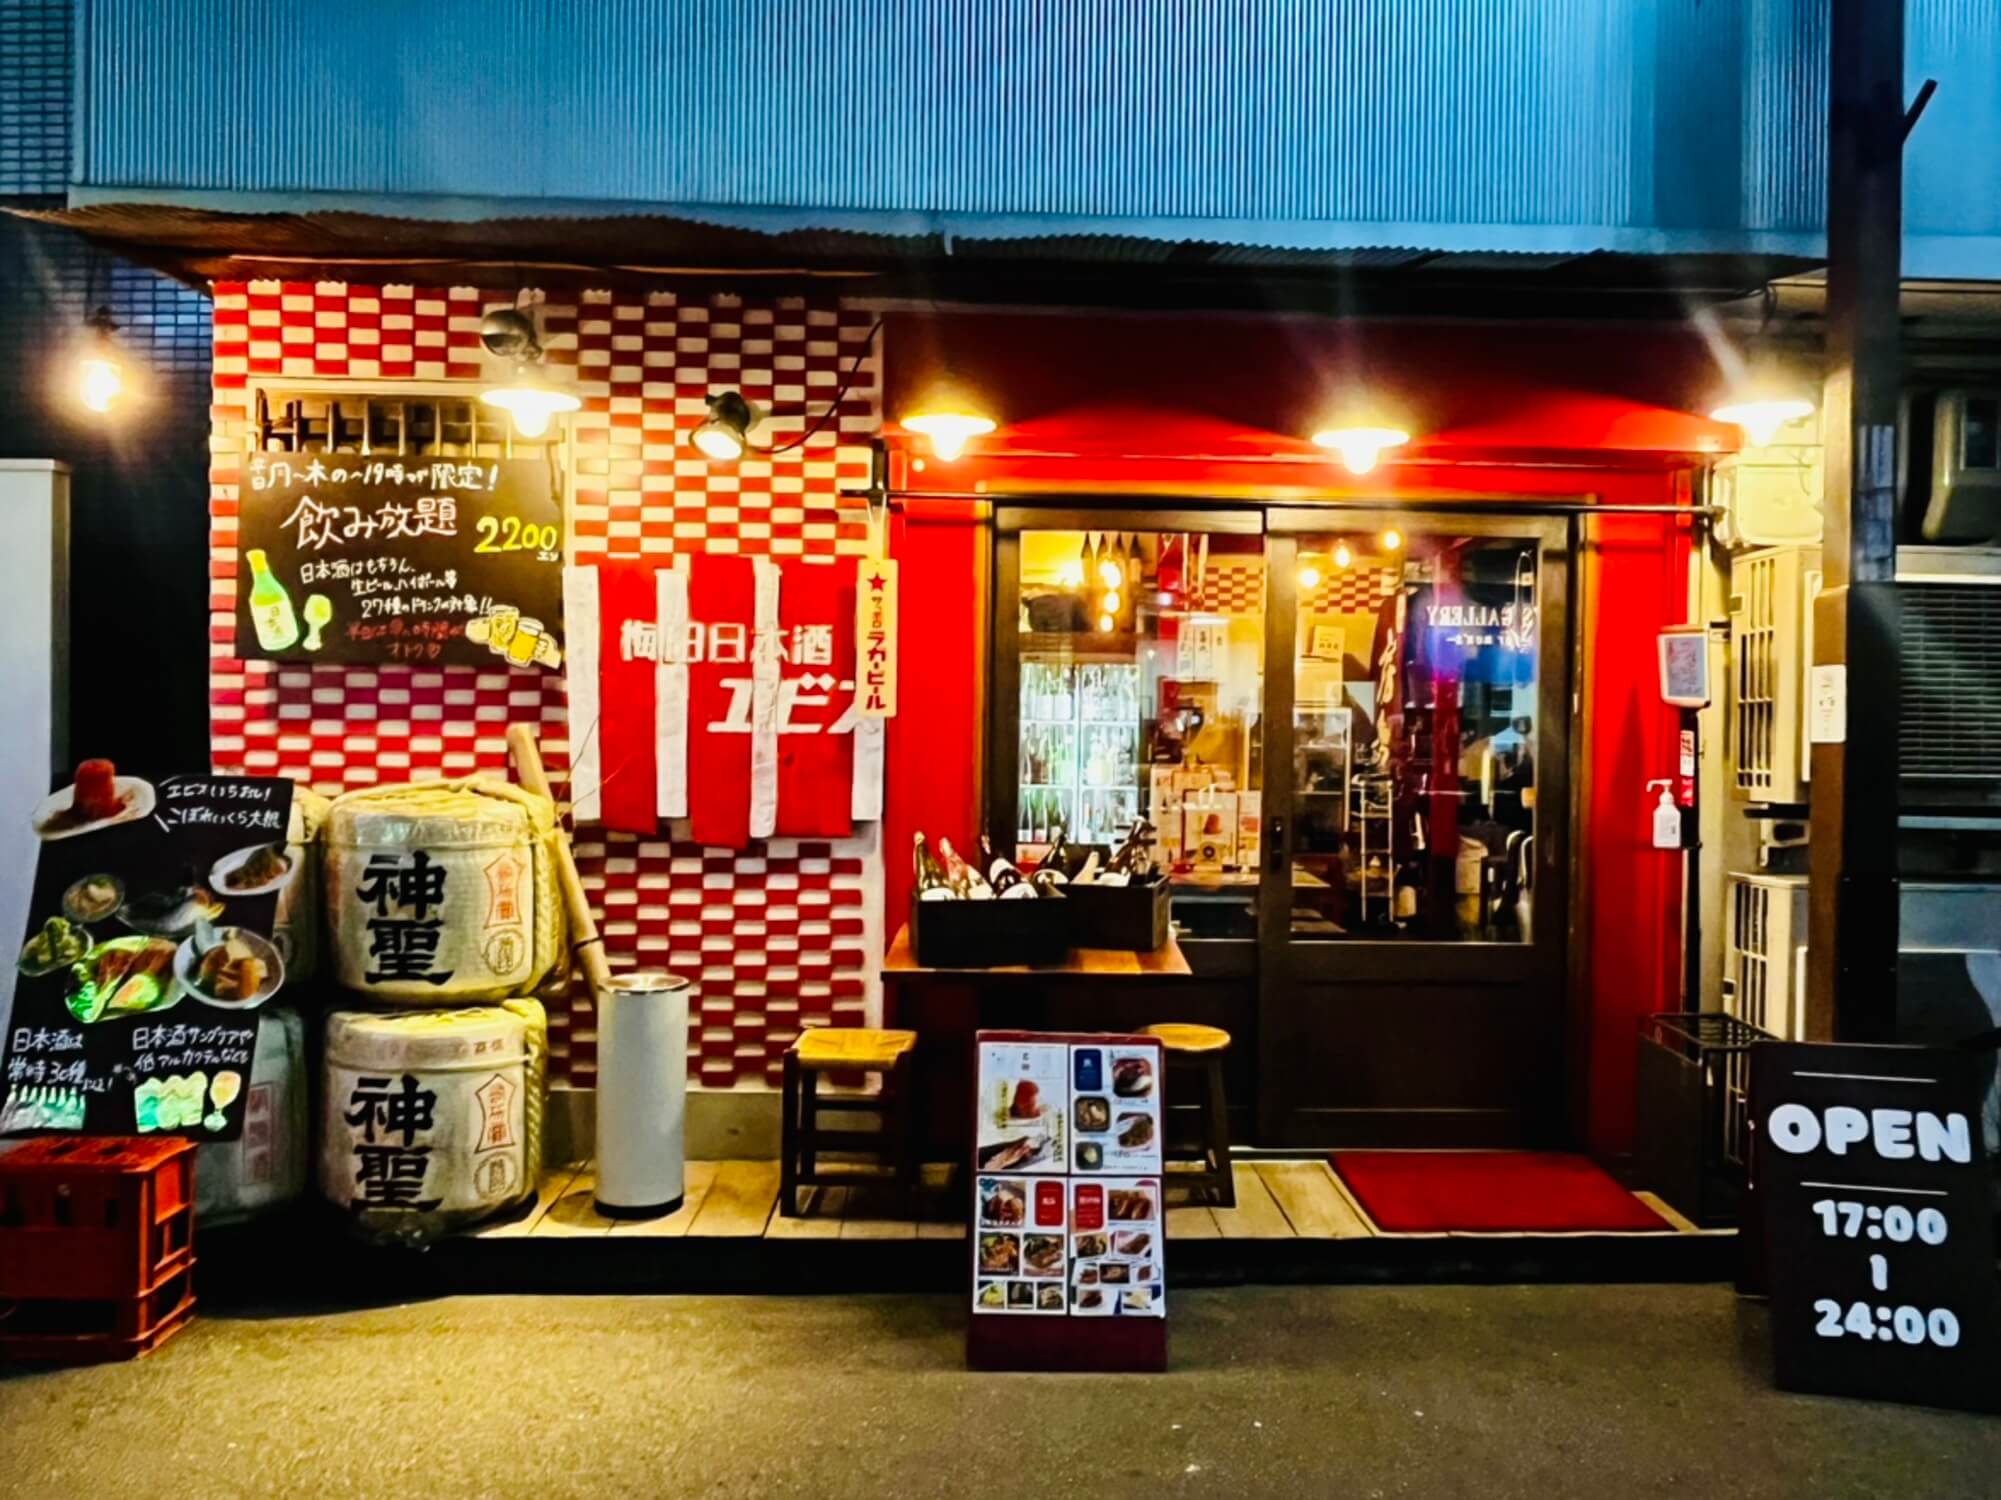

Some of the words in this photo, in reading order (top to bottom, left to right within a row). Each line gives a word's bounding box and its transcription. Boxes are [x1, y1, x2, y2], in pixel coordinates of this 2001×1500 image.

[279, 495, 459, 551] 飲み放題
[473, 515, 558, 554] 2200
[620, 618, 834, 665] 梅田日本酒
[356, 850, 455, 985] 神聖
[13, 1027, 84, 1052] 日本酒は
[344, 1074, 443, 1212] 神聖
[1768, 1103, 1972, 1164] OPEN
[1812, 1199, 1948, 1245] 17:00
[1814, 1299, 1960, 1347] 24:00
